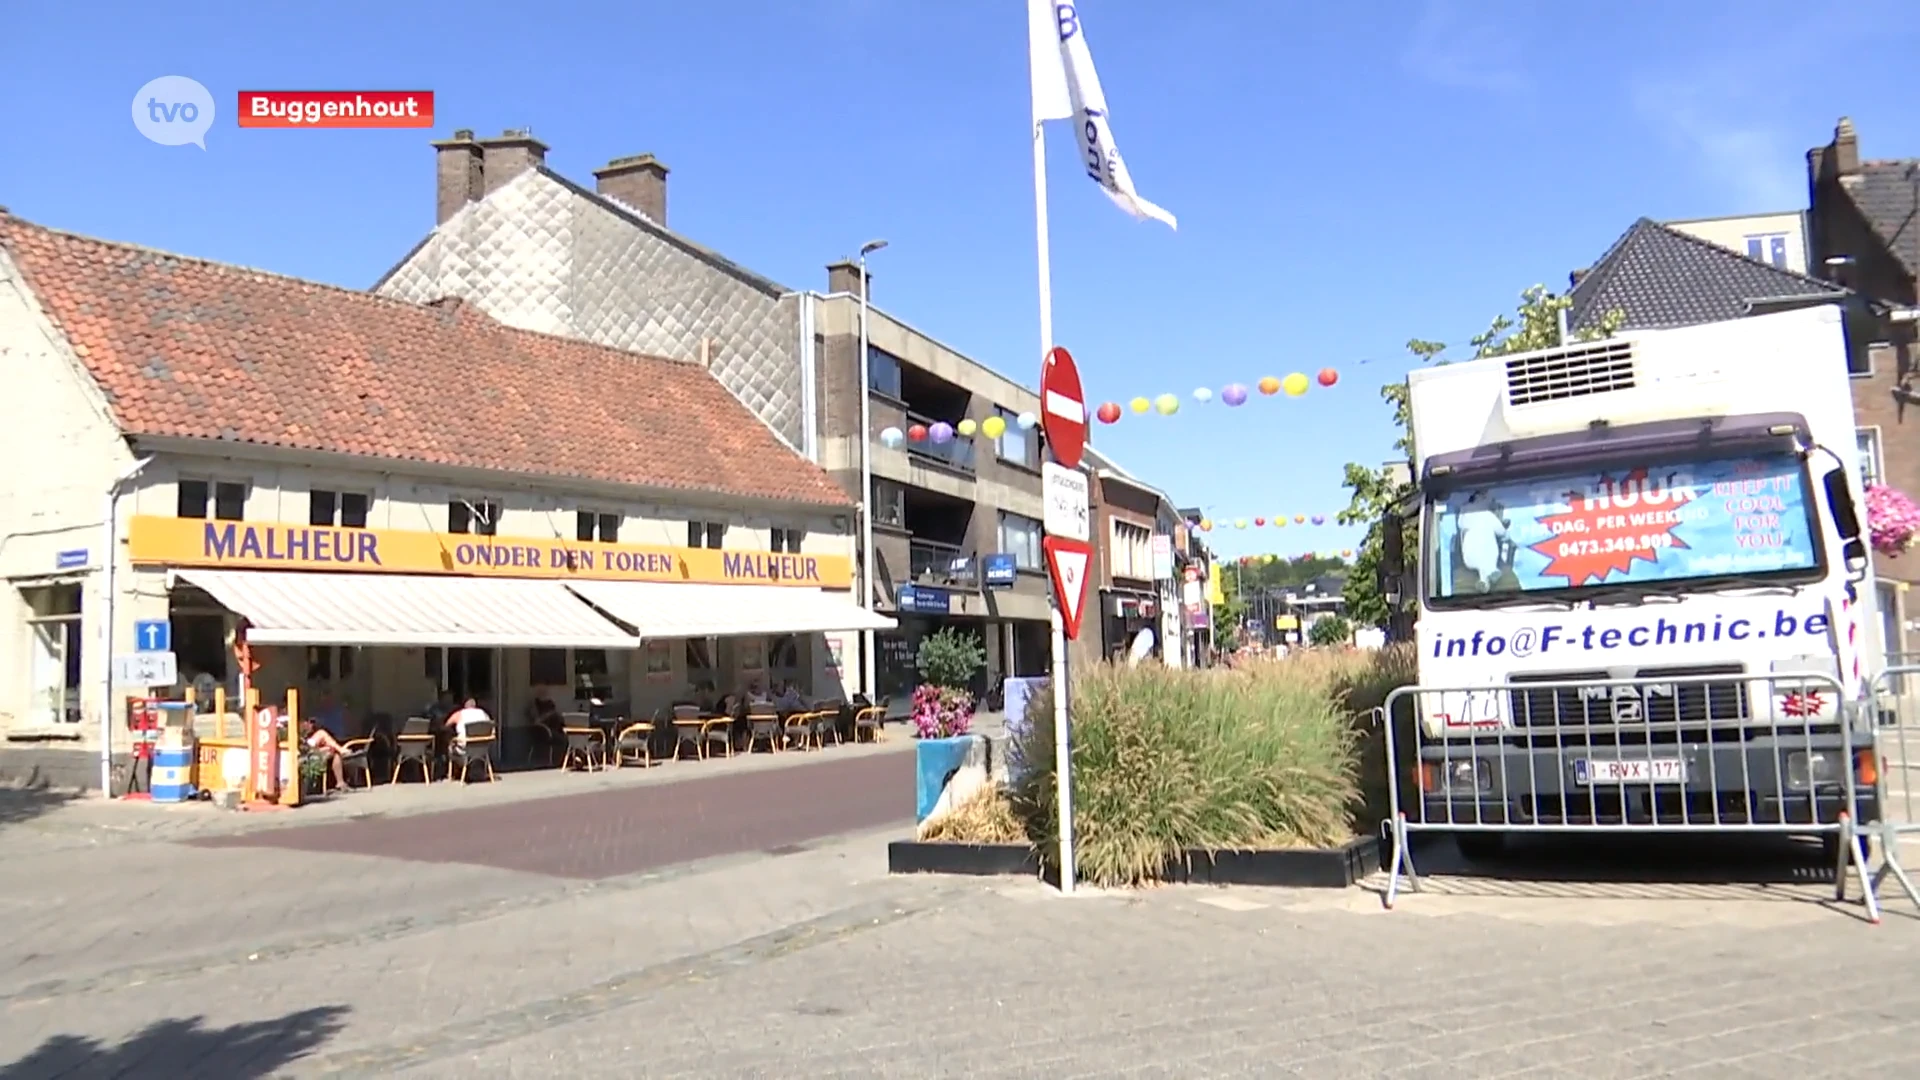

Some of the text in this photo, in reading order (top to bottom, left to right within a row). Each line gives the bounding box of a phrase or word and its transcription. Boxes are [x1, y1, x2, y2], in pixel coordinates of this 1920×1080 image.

[1583, 473, 1698, 511] HUUR
[1725, 495, 1785, 513] COOL
[1552, 519, 1591, 534] DAG,
[1596, 514, 1626, 529] PER
[1735, 514, 1779, 530] FOR
[204, 521, 381, 565] MALHEUR
[1736, 532, 1783, 549] YOU
[456, 543, 673, 573] ONDER DEN TOREN
[723, 551, 819, 581] MALHEUR
[1433, 609, 1829, 658] info@F-technic.be
[1578, 682, 1673, 699] MAN
[257, 708, 272, 793] OPEN
